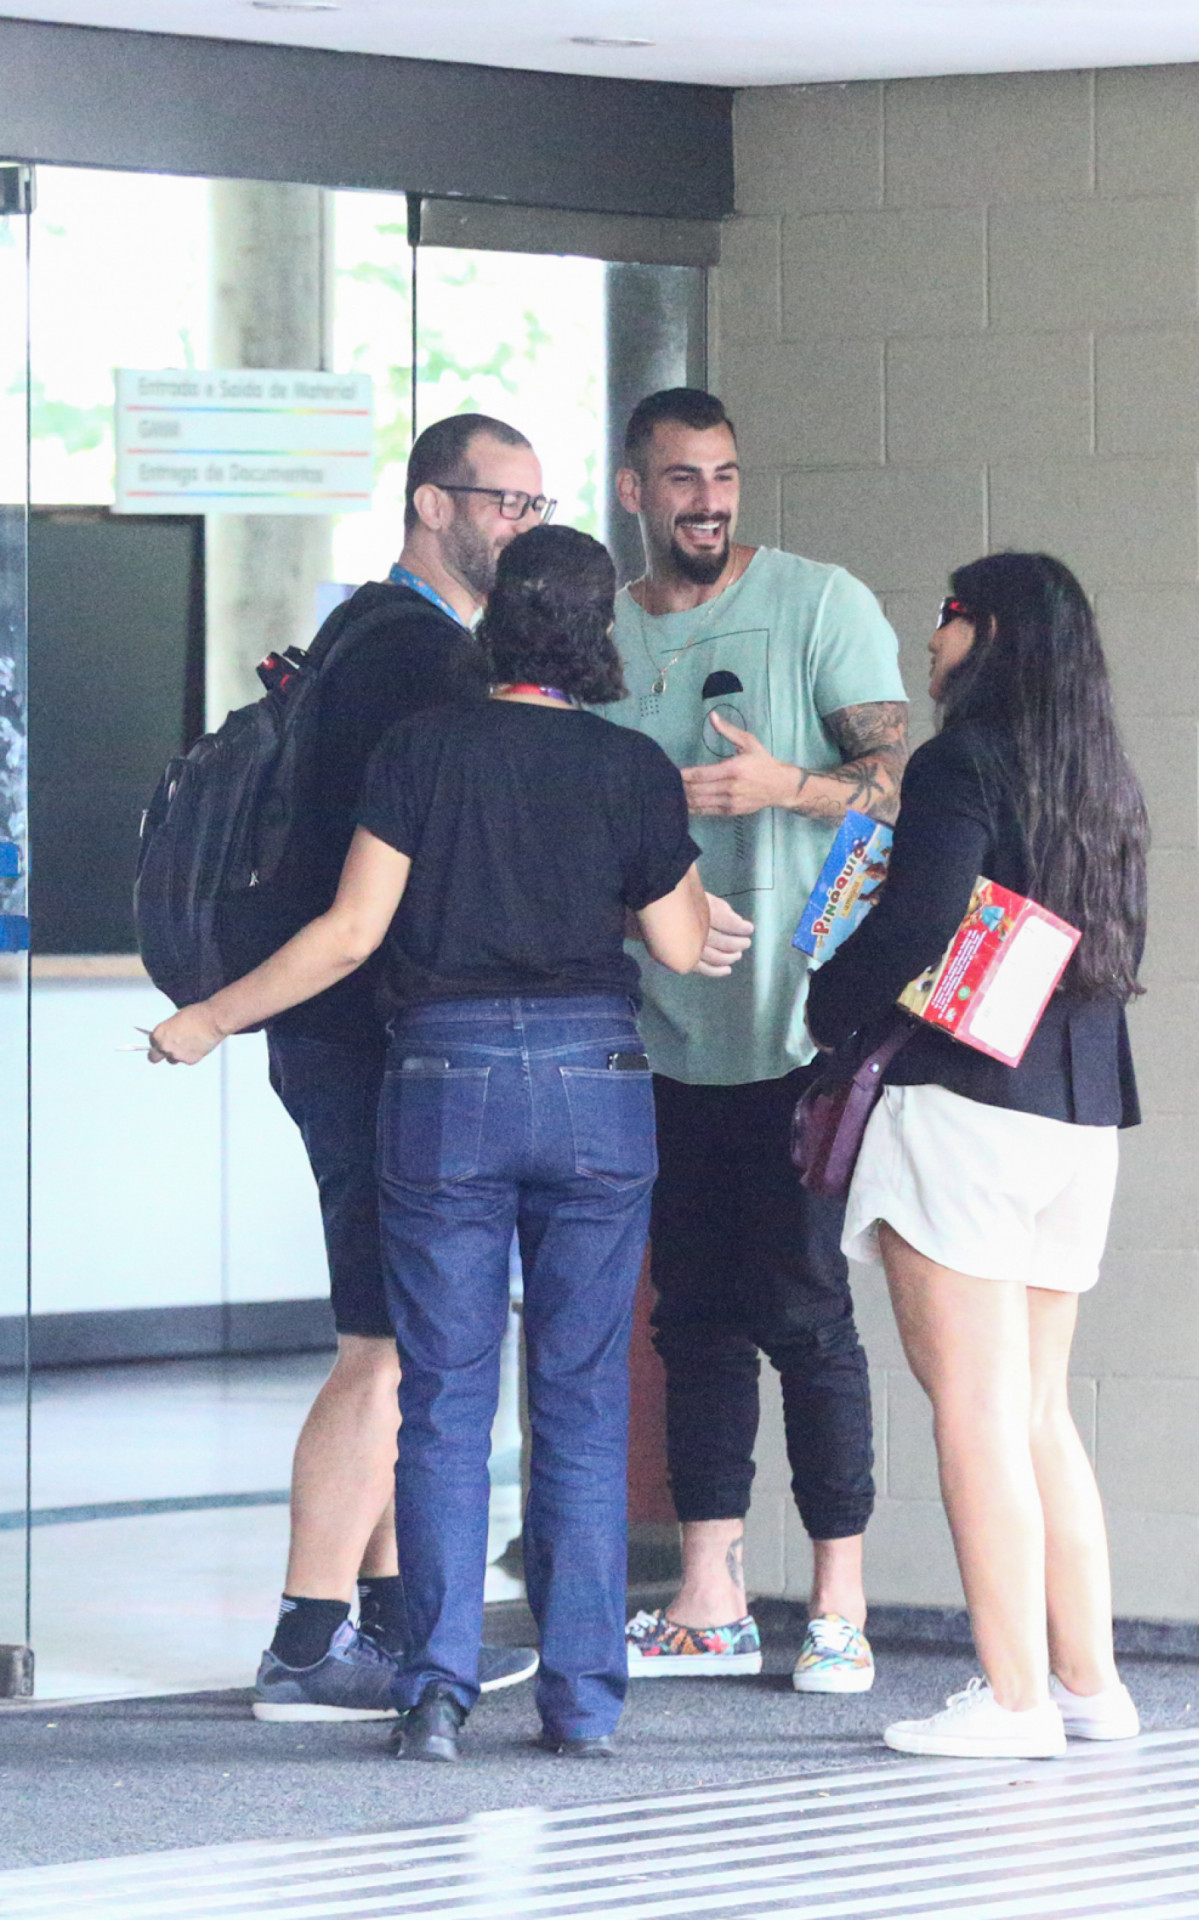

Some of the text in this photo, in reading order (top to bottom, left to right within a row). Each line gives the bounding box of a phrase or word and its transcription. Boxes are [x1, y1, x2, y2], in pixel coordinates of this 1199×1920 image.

[138, 377, 199, 397] Entrada
[206, 382, 214, 397] e
[271, 380, 287, 399] de
[294, 381, 358, 400] Material
[138, 464, 323, 487] Entrega de Documentos
